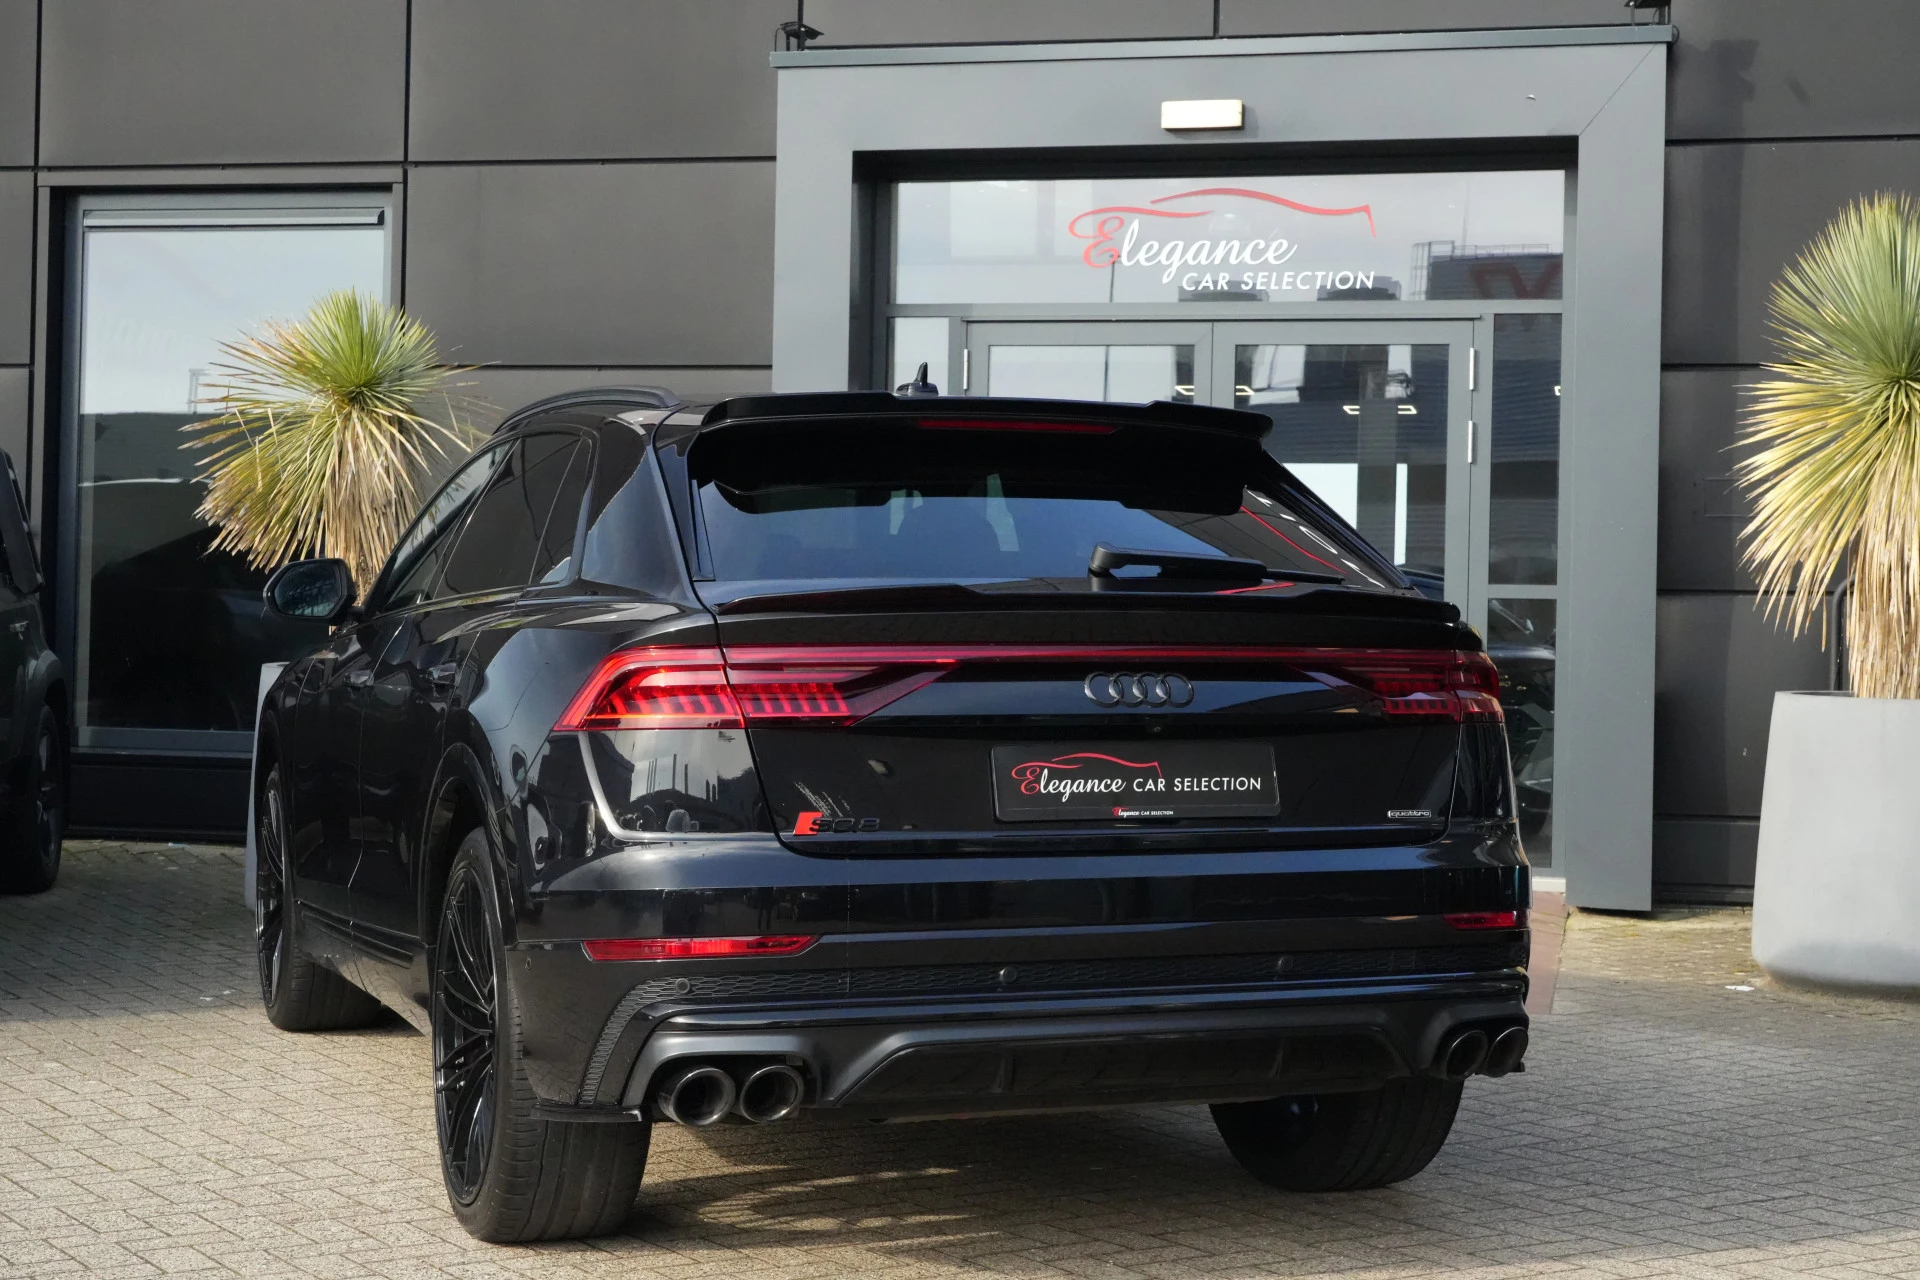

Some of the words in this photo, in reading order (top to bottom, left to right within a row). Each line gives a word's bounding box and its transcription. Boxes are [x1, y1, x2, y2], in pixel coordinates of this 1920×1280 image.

[1069, 207, 1298, 284] Elegance
[1182, 272, 1228, 291] CAR
[1241, 271, 1375, 290] SELECTION
[1012, 762, 1126, 802] Elegance
[1133, 778, 1166, 792] CAR
[1173, 777, 1261, 791] SELECTION
[1112, 807, 1140, 818] Elegance
[809, 817, 880, 832] SQ8
